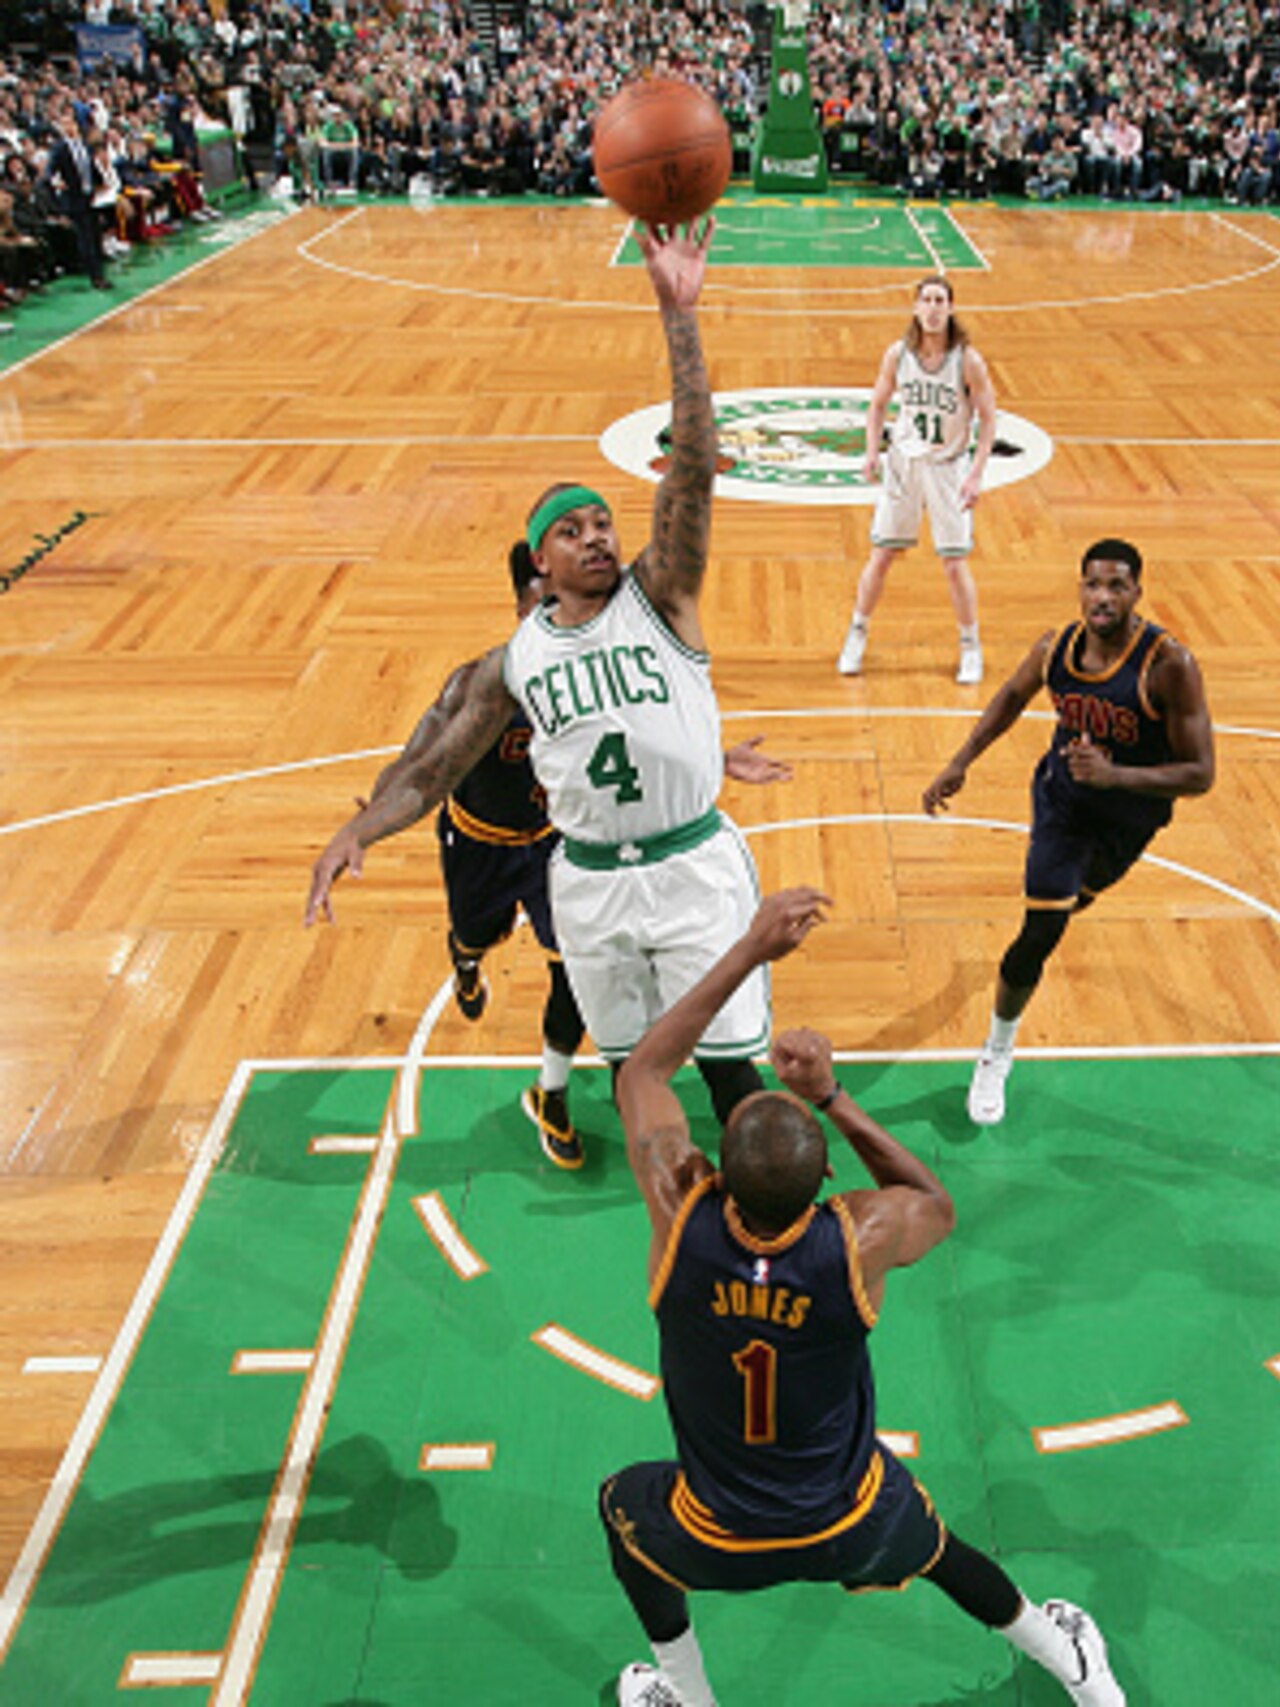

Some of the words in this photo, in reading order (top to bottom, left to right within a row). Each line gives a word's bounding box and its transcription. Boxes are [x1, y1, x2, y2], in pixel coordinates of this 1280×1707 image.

[914, 412, 944, 444] 41
[524, 645, 669, 736] CELTICS
[586, 732, 643, 805] 4
[710, 1280, 812, 1329] JONES
[731, 1339, 777, 1445] 1
